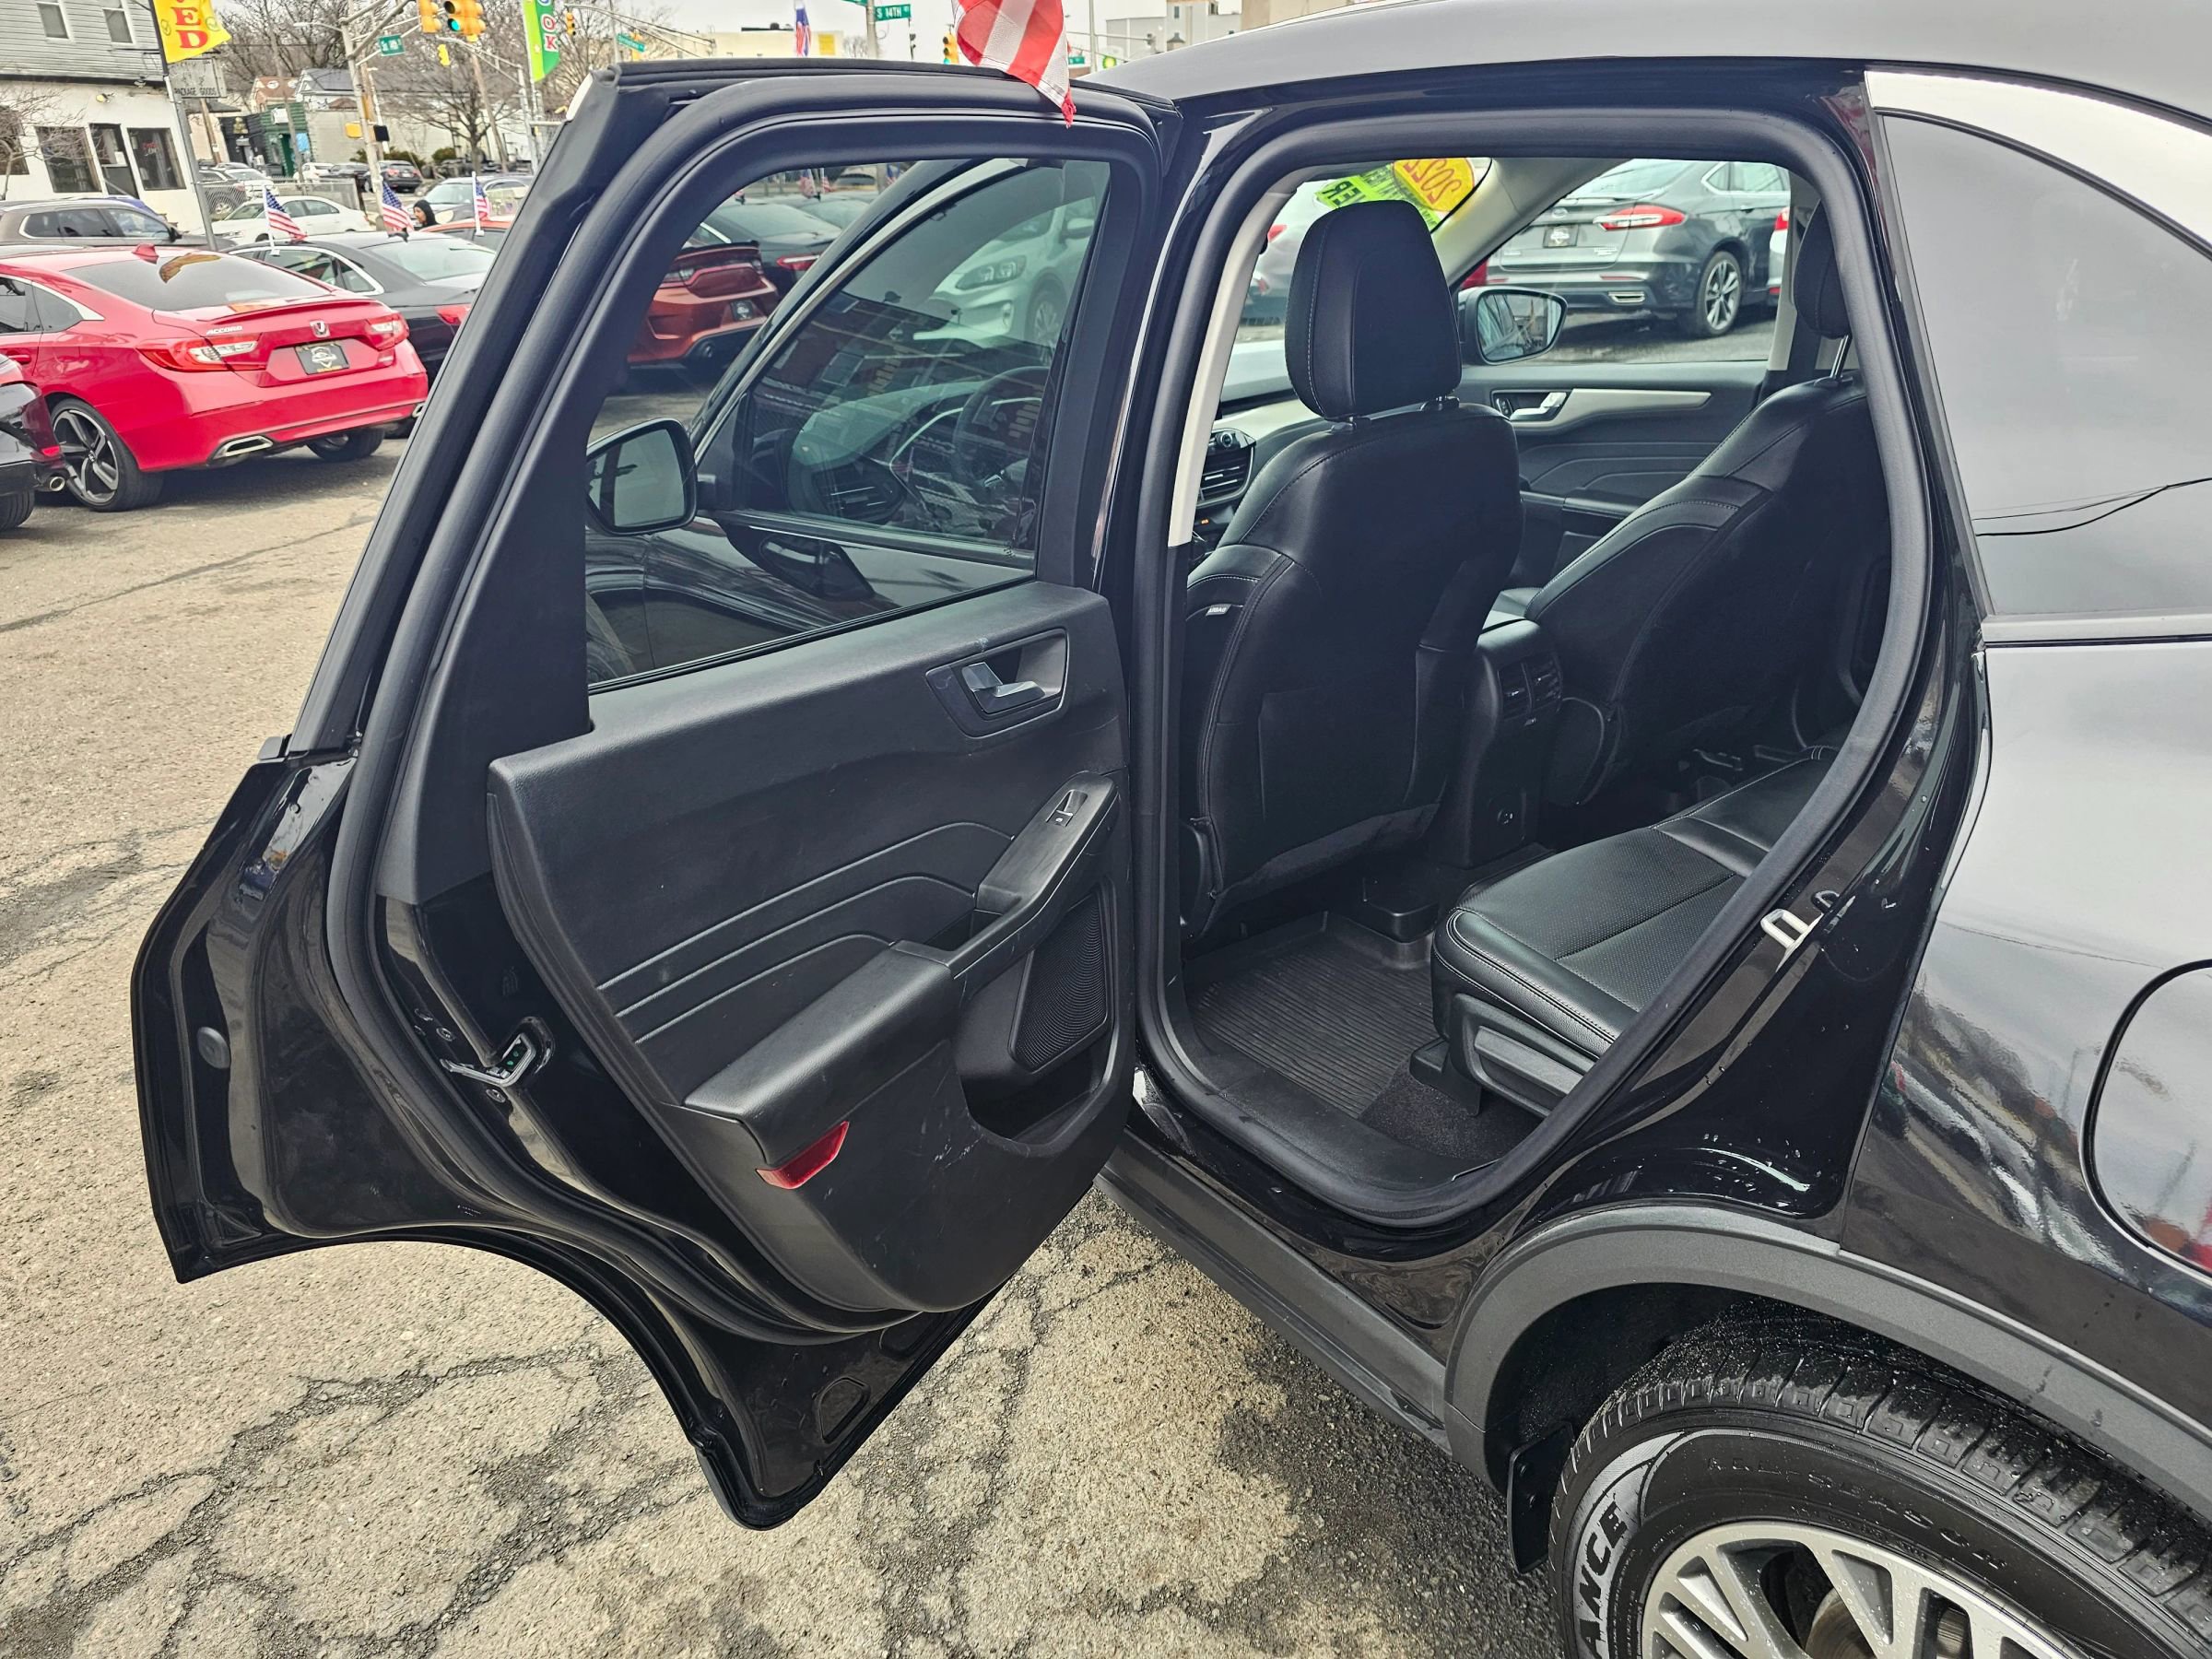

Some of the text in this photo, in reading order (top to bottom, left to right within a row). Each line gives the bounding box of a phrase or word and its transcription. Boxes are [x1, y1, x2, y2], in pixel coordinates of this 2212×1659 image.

[171, 0, 208, 49] ED
[537, 0, 558, 50] OK
[206, 325, 243, 335] ACCORD
